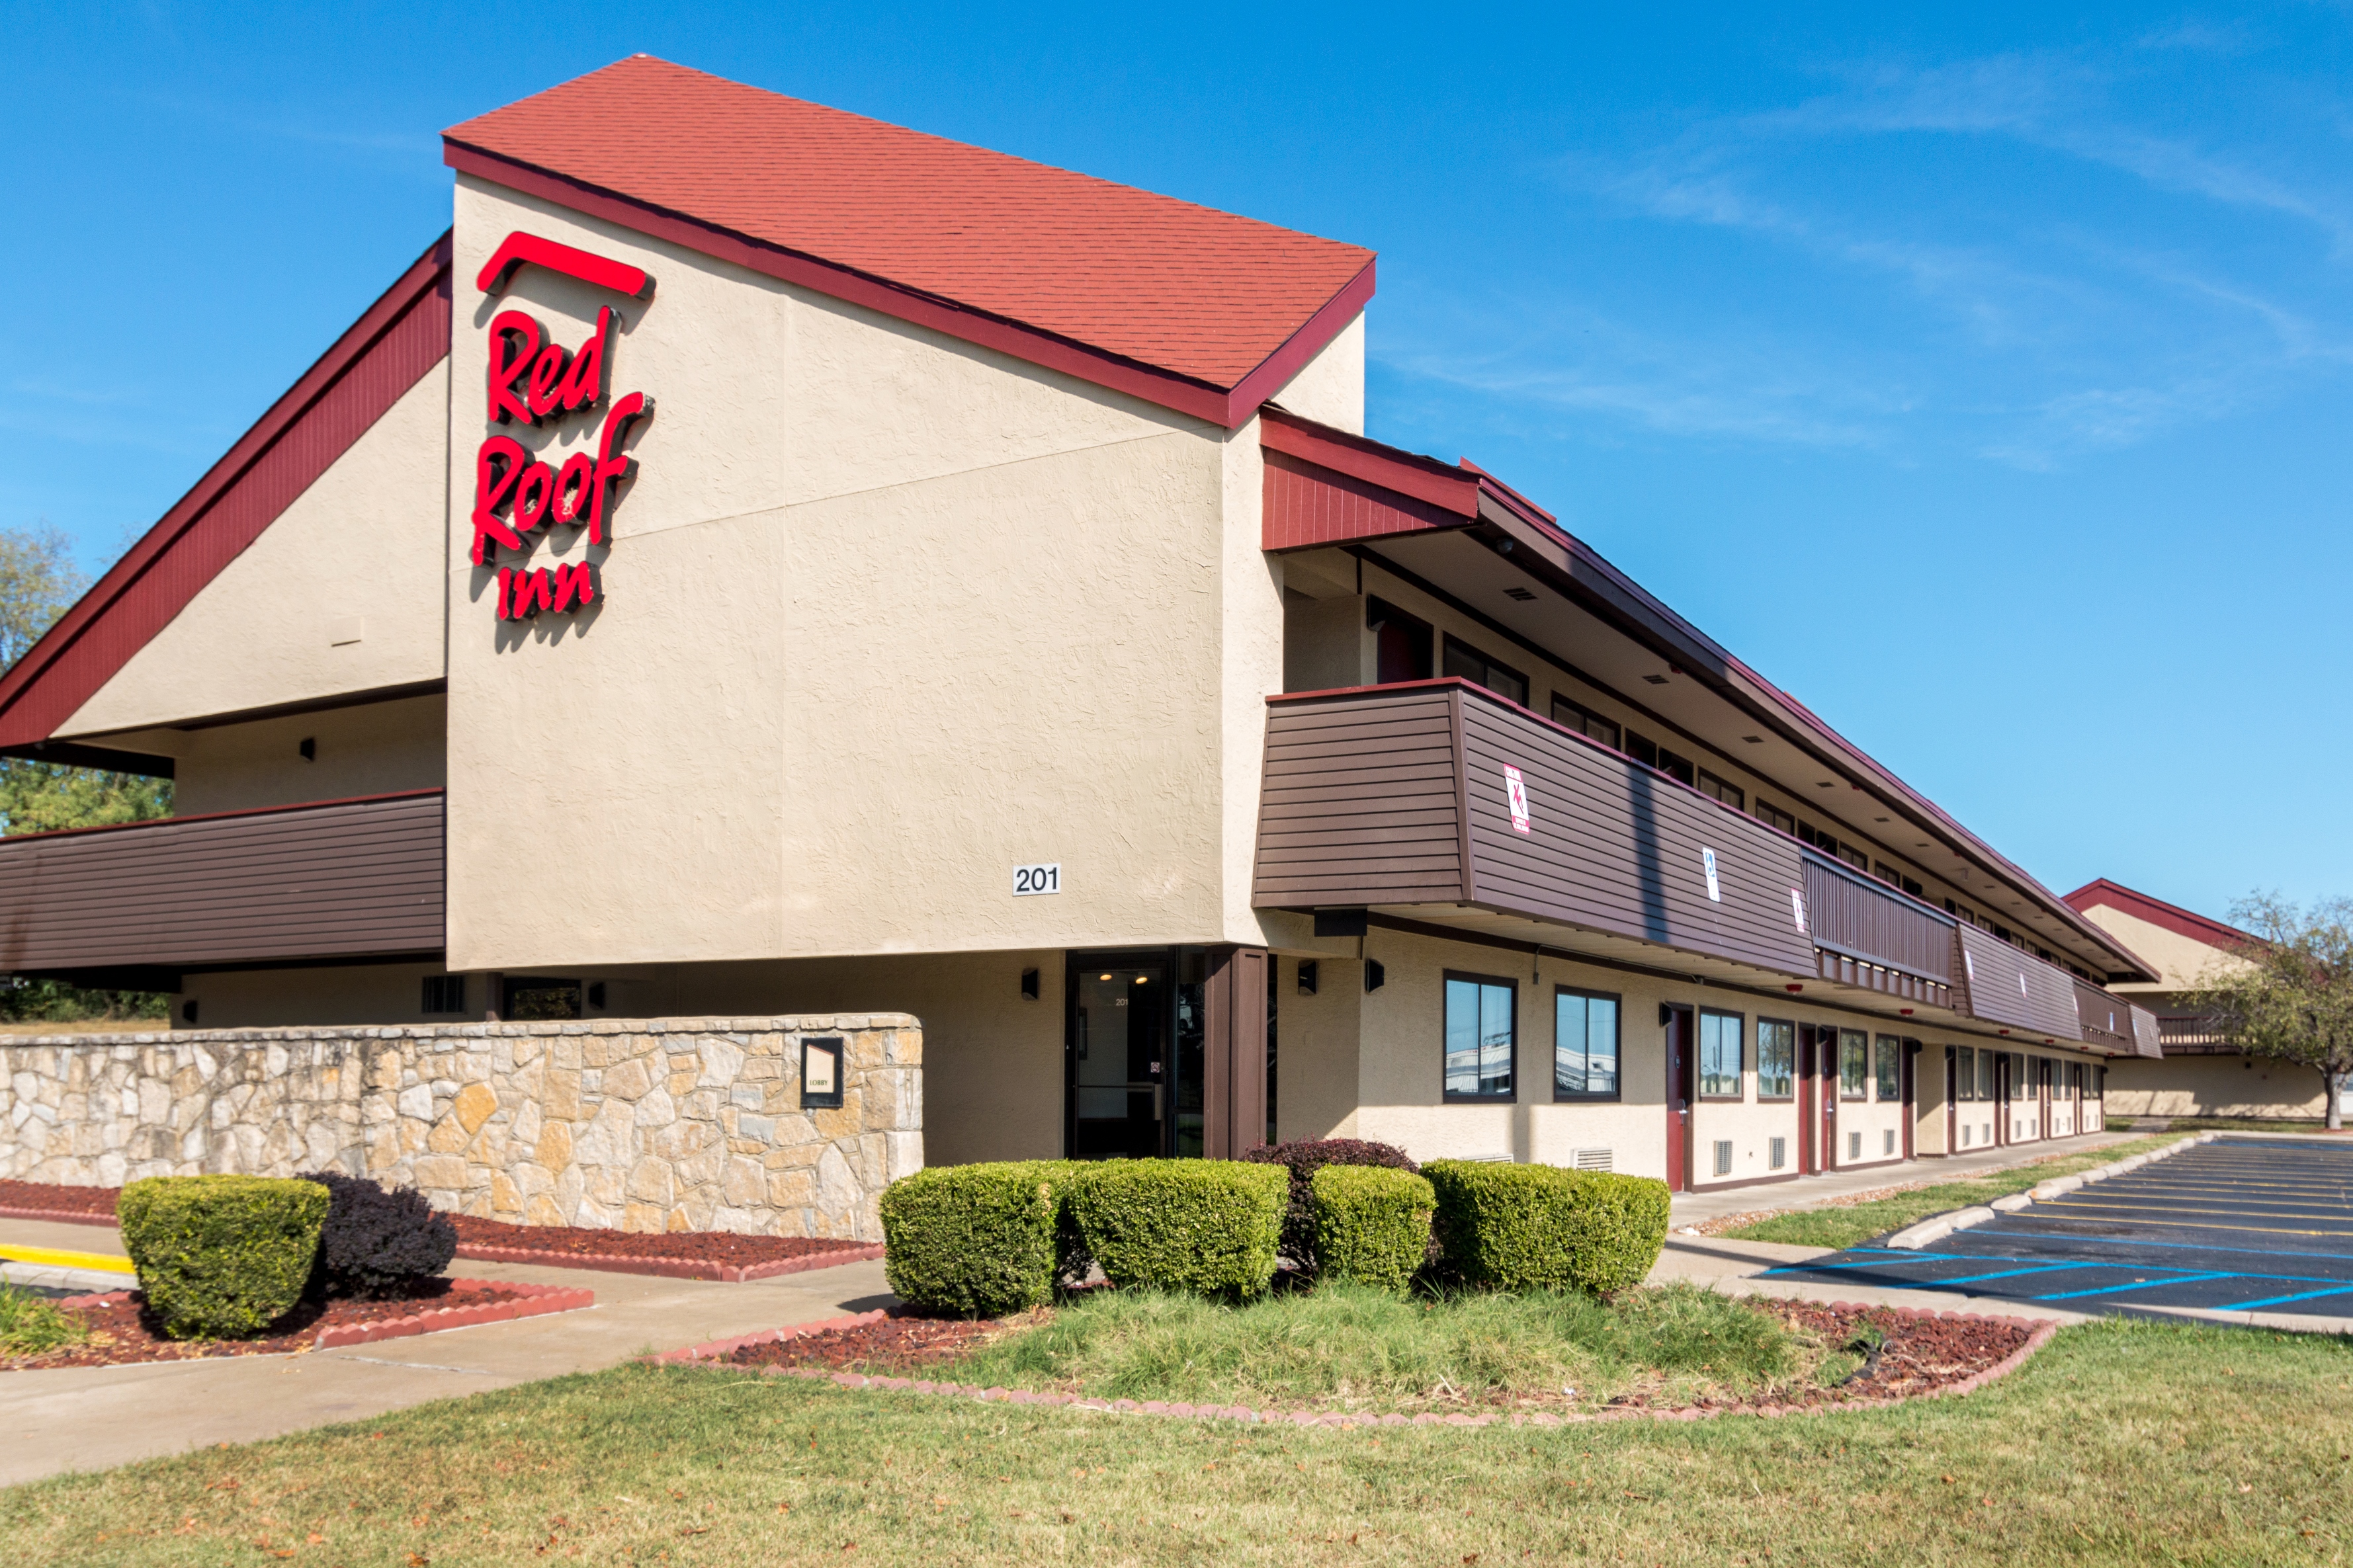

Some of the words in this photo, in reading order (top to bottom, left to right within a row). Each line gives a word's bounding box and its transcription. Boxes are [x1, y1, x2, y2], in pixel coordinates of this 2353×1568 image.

[488, 305, 611, 425] Red
[471, 391, 646, 567] Roof
[1016, 866, 1057, 892] 201
